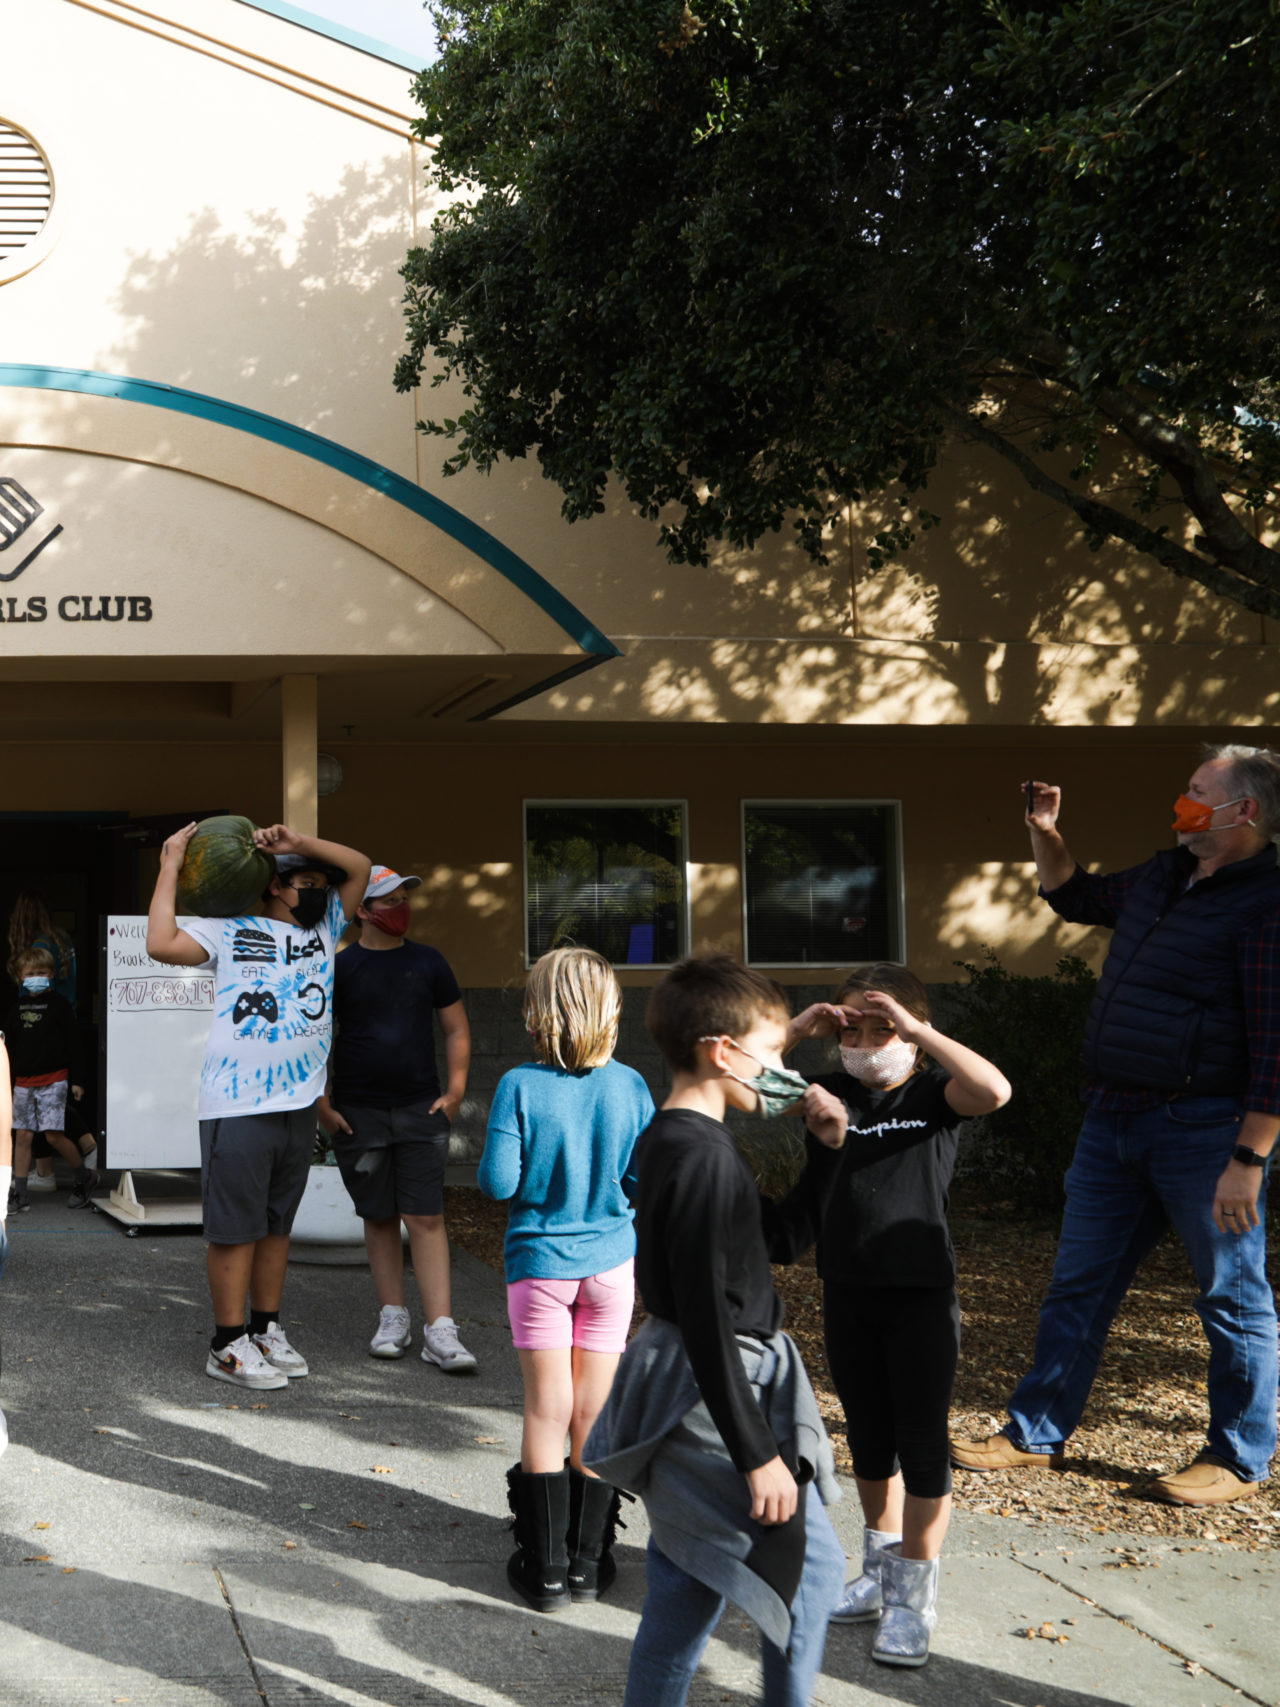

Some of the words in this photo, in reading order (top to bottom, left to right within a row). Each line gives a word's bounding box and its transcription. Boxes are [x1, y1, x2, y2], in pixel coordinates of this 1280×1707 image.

[58, 595, 153, 622] CLUB
[241, 966, 266, 978] EAT
[233, 1029, 273, 1040] GAME
[294, 1023, 332, 1038] REPEAT
[846, 1118, 927, 1138] ampion
